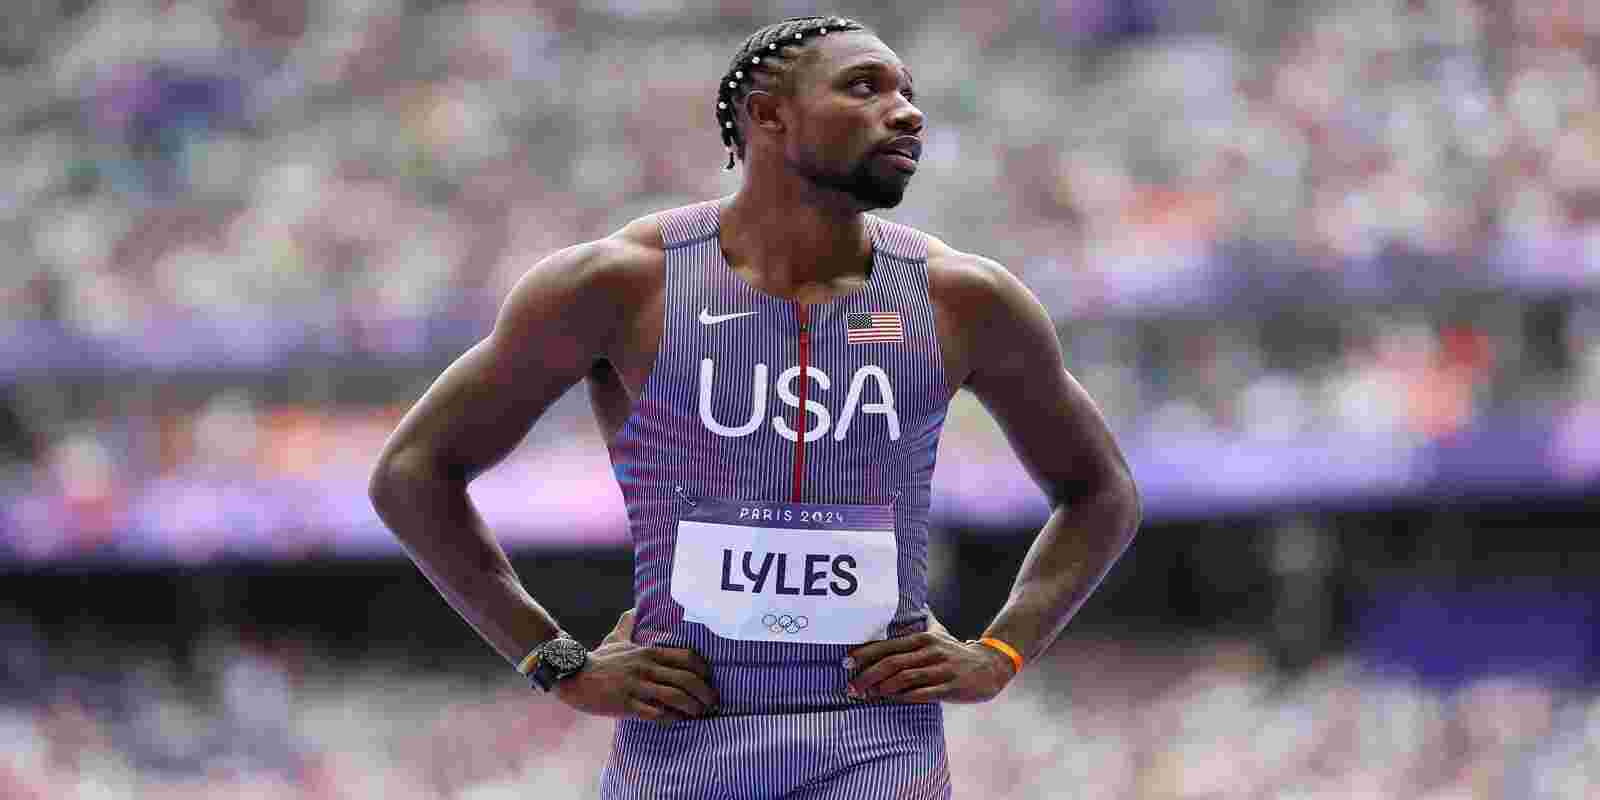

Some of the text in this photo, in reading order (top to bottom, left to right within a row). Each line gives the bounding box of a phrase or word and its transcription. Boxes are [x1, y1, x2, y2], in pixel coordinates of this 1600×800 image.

[699, 358, 900, 441] USA
[738, 507, 844, 522] PARIS 2024
[720, 548, 858, 597] LYLES
